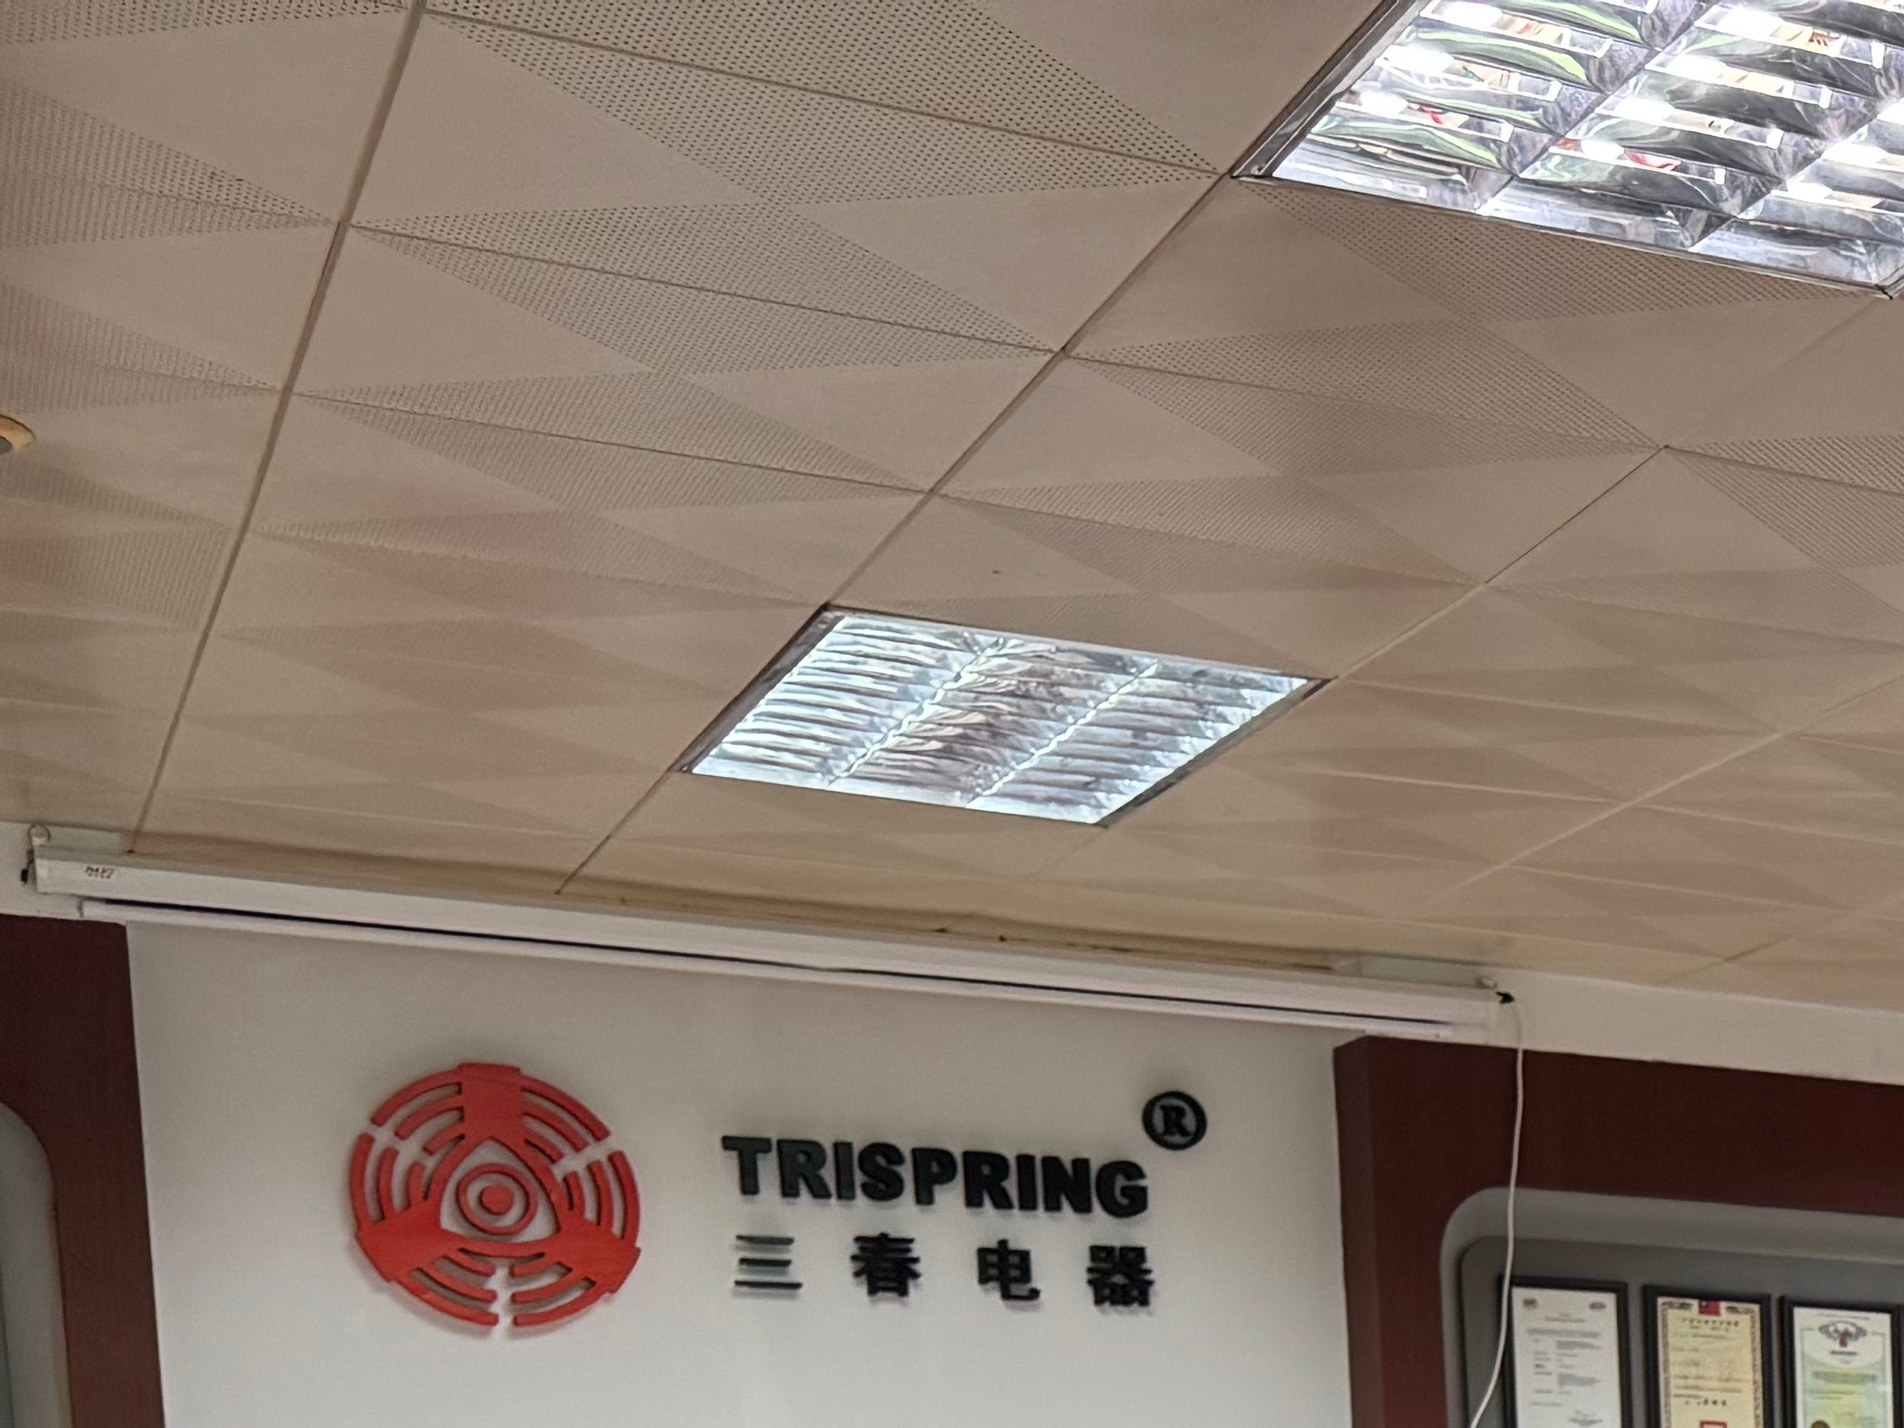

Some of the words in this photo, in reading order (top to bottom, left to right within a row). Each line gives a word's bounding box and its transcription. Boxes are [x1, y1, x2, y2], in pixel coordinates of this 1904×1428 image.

[721, 1134, 1149, 1219] TRISPRING
[733, 1232, 1156, 1310] 三春电器
